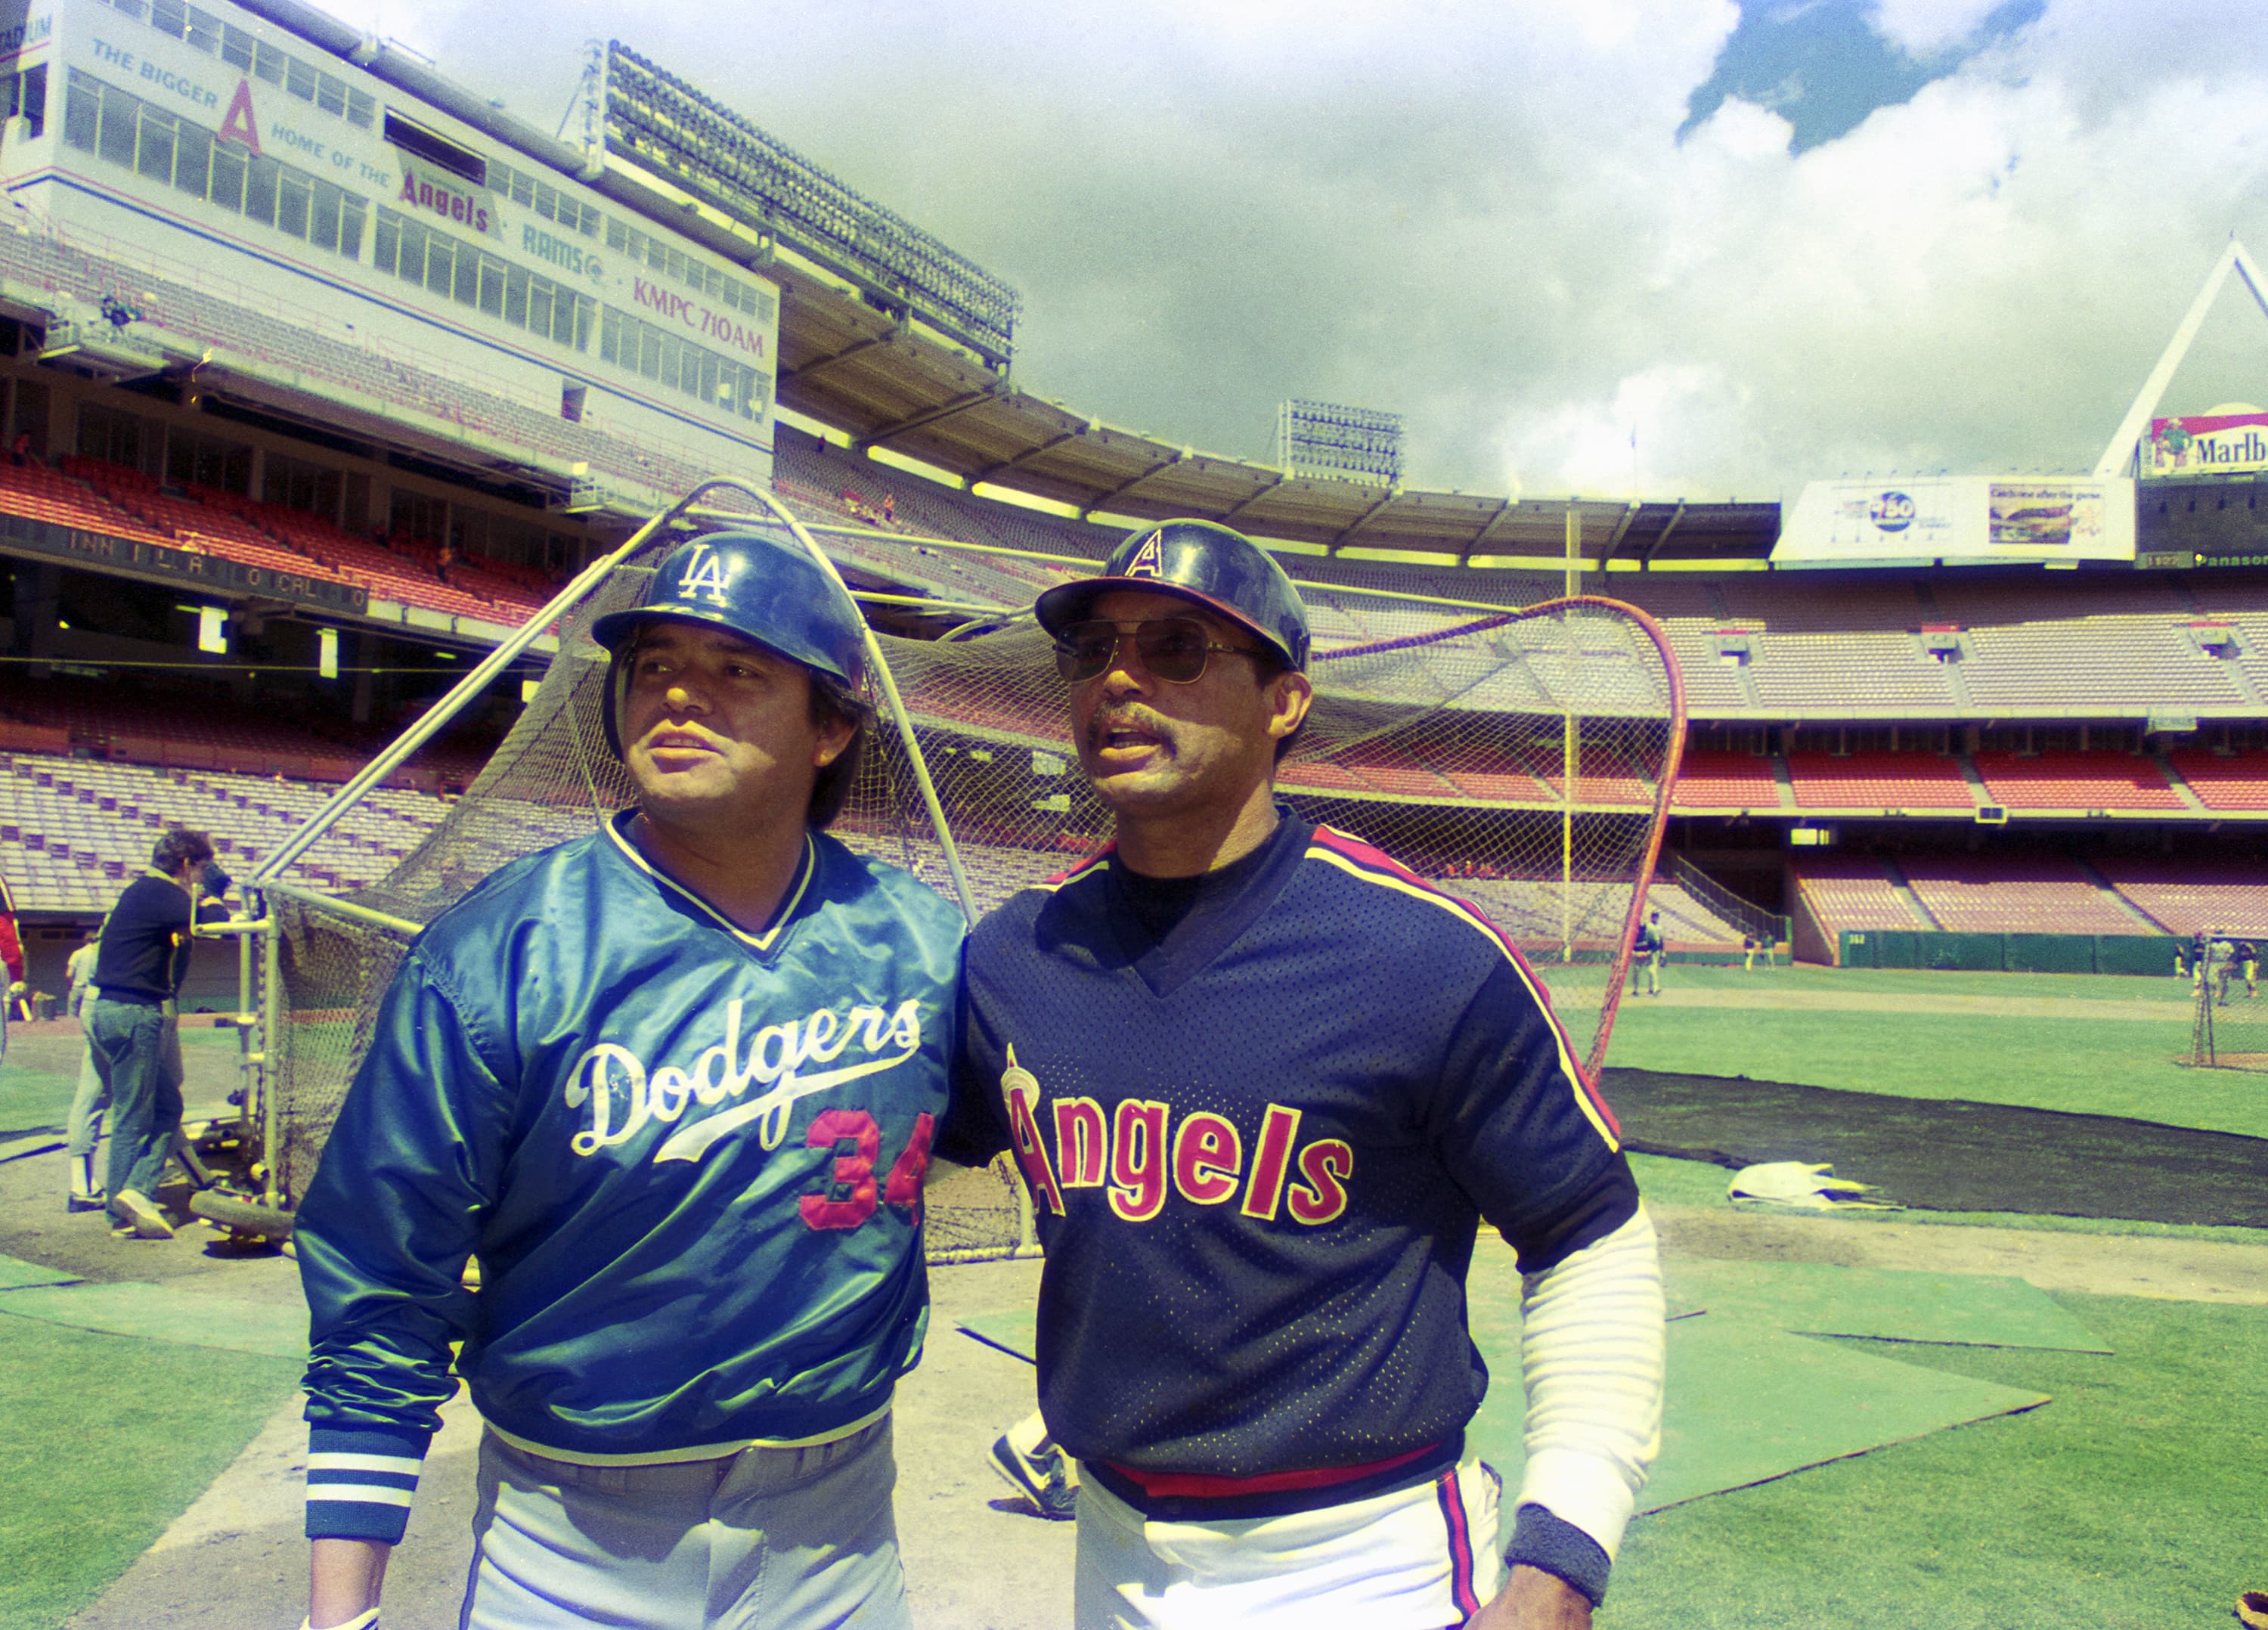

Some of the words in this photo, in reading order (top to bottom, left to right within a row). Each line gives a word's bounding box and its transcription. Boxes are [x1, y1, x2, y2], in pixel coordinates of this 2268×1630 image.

[93, 37, 135, 71] THE
[139, 61, 218, 110] BIGGER
[218, 78, 262, 158] A
[271, 122, 325, 158] HOME
[331, 150, 355, 170] OF
[359, 163, 390, 188] THE
[399, 169, 488, 232] Angels
[634, 276, 696, 327] KMPC
[2196, 432, 2267, 464] Marlb
[2037, 489, 2057, 497] after
[678, 544, 731, 608] LA
[1124, 528, 1163, 578] A
[565, 999, 921, 1156] Dodgers
[1000, 1043, 1353, 1225] Angels
[799, 1109, 934, 1231] 34
